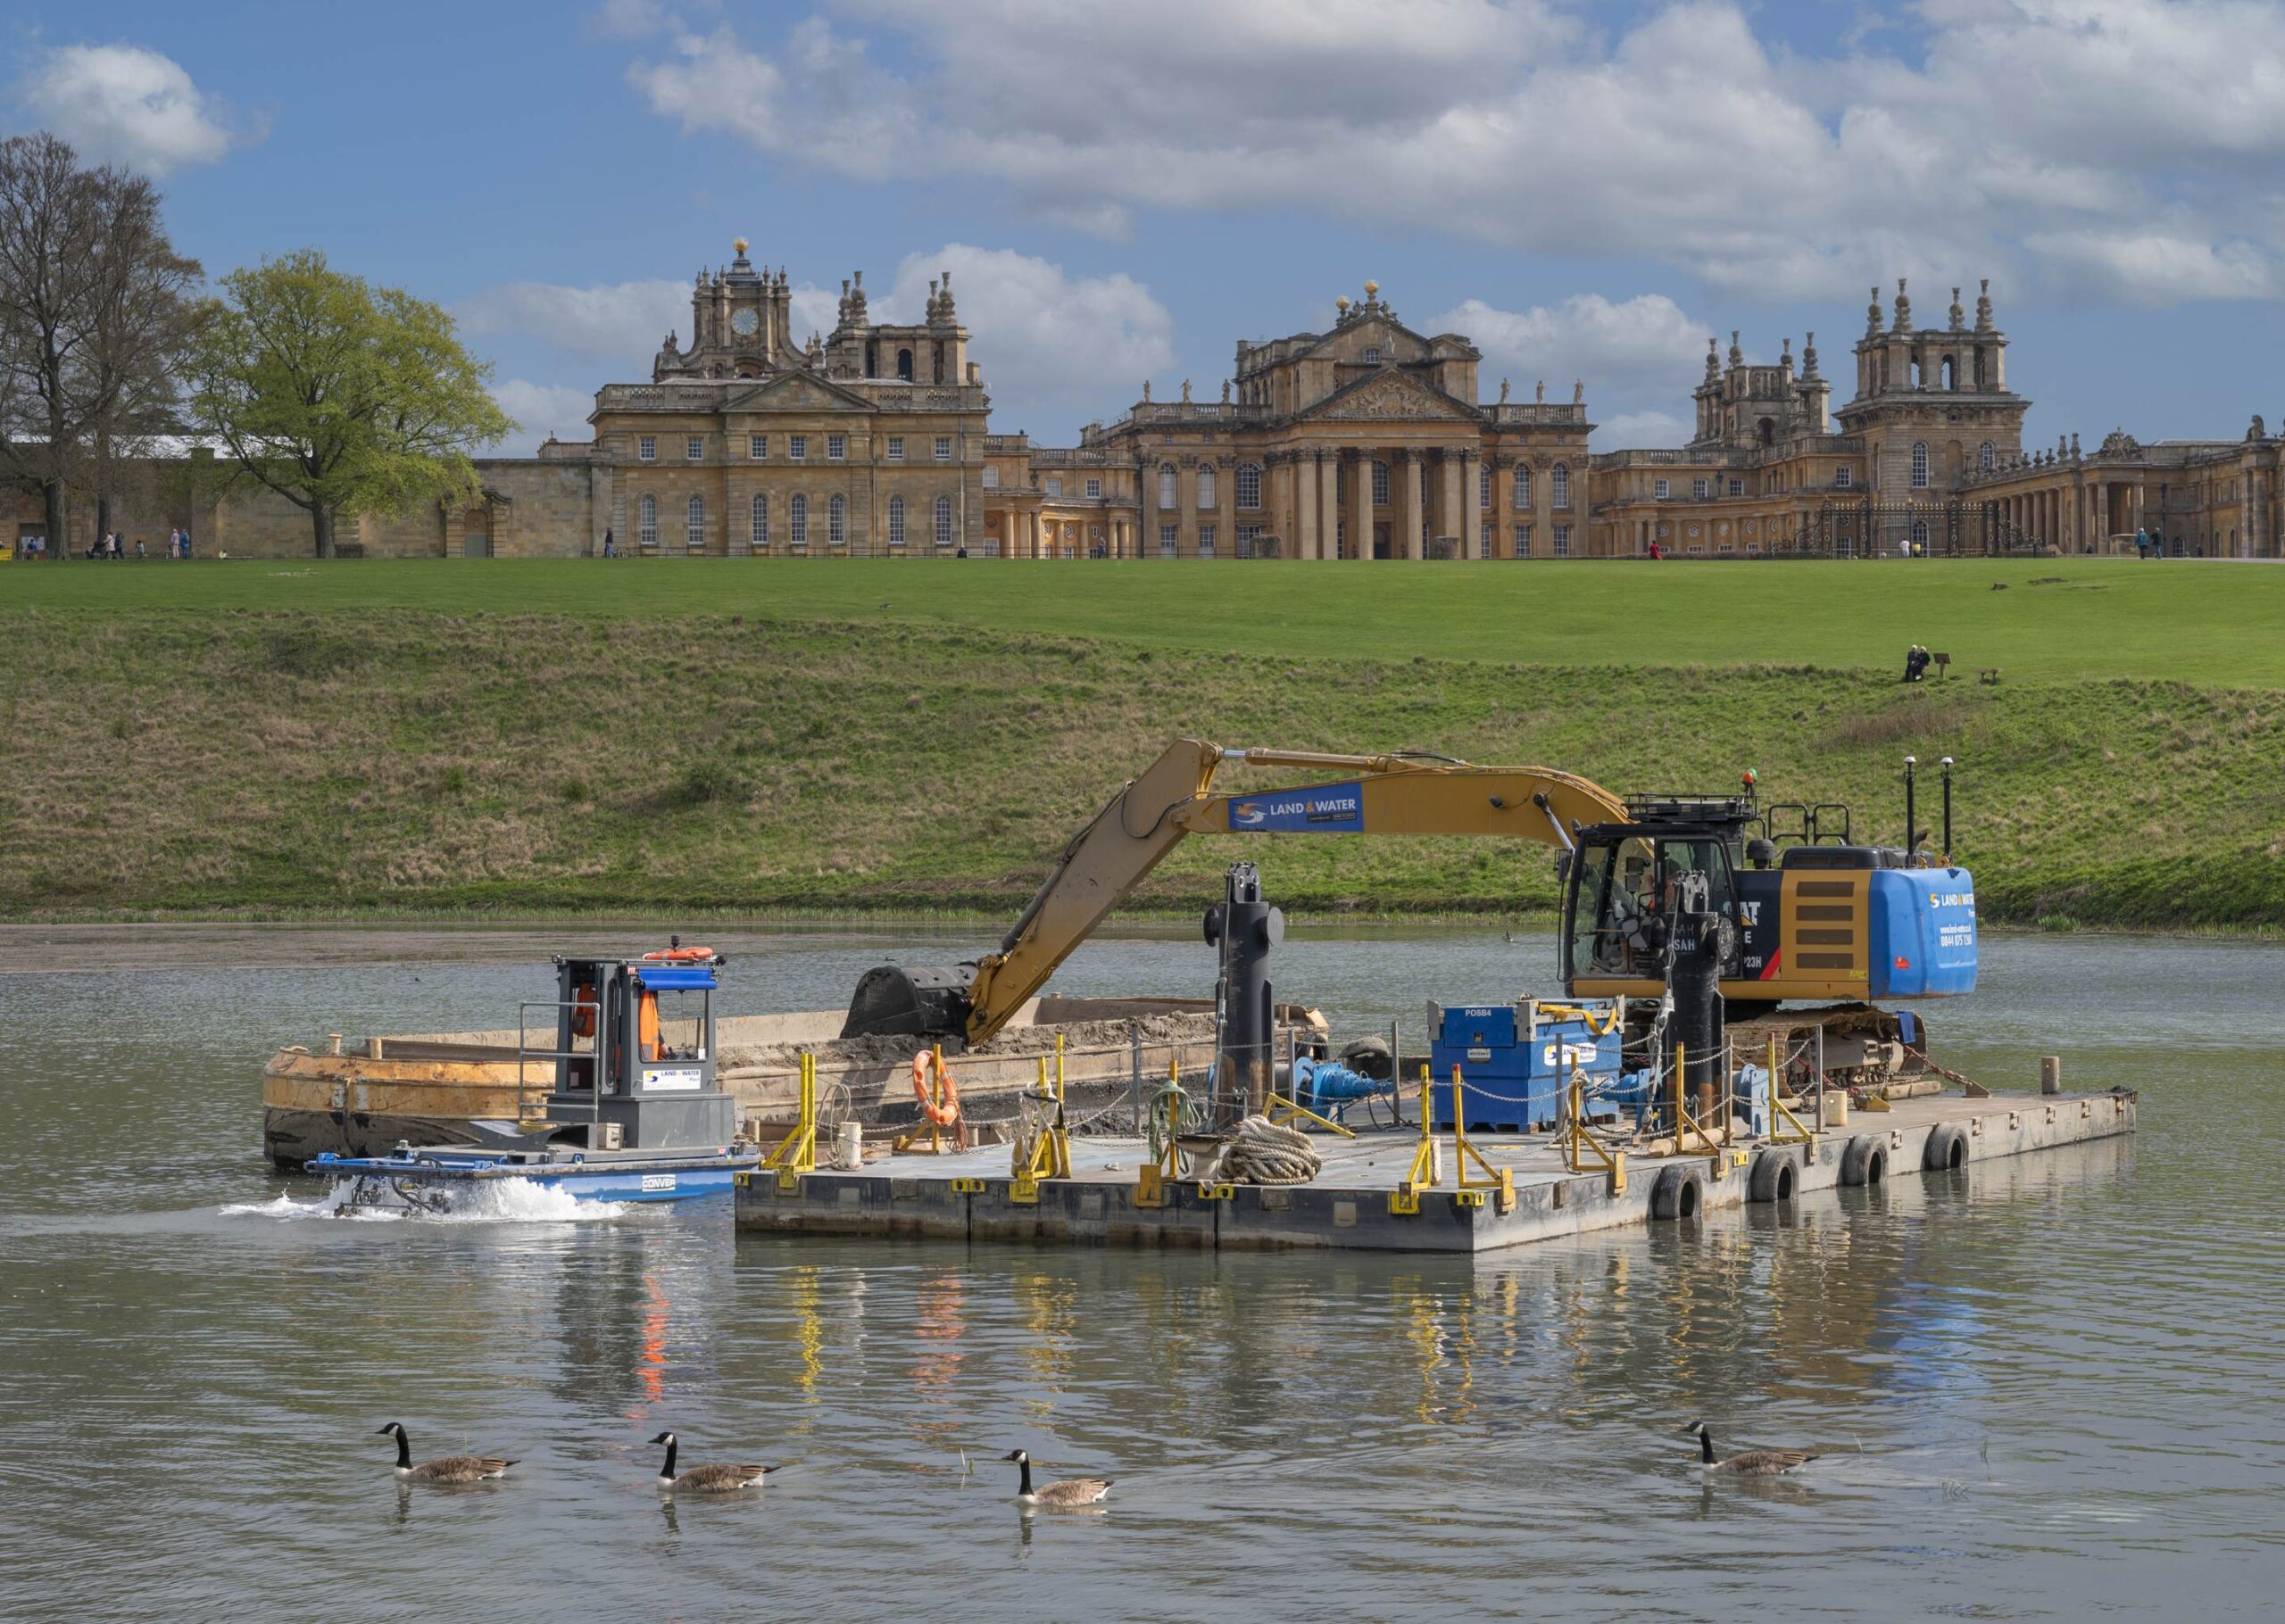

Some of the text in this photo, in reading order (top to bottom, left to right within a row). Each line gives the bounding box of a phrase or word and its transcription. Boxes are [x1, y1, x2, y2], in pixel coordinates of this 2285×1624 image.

[1270, 799, 1357, 816] LAND & WATER
[1941, 894, 1957, 906] LAND
[1465, 1009, 1491, 1017] POSB4
[642, 1177, 676, 1189] CONVER
